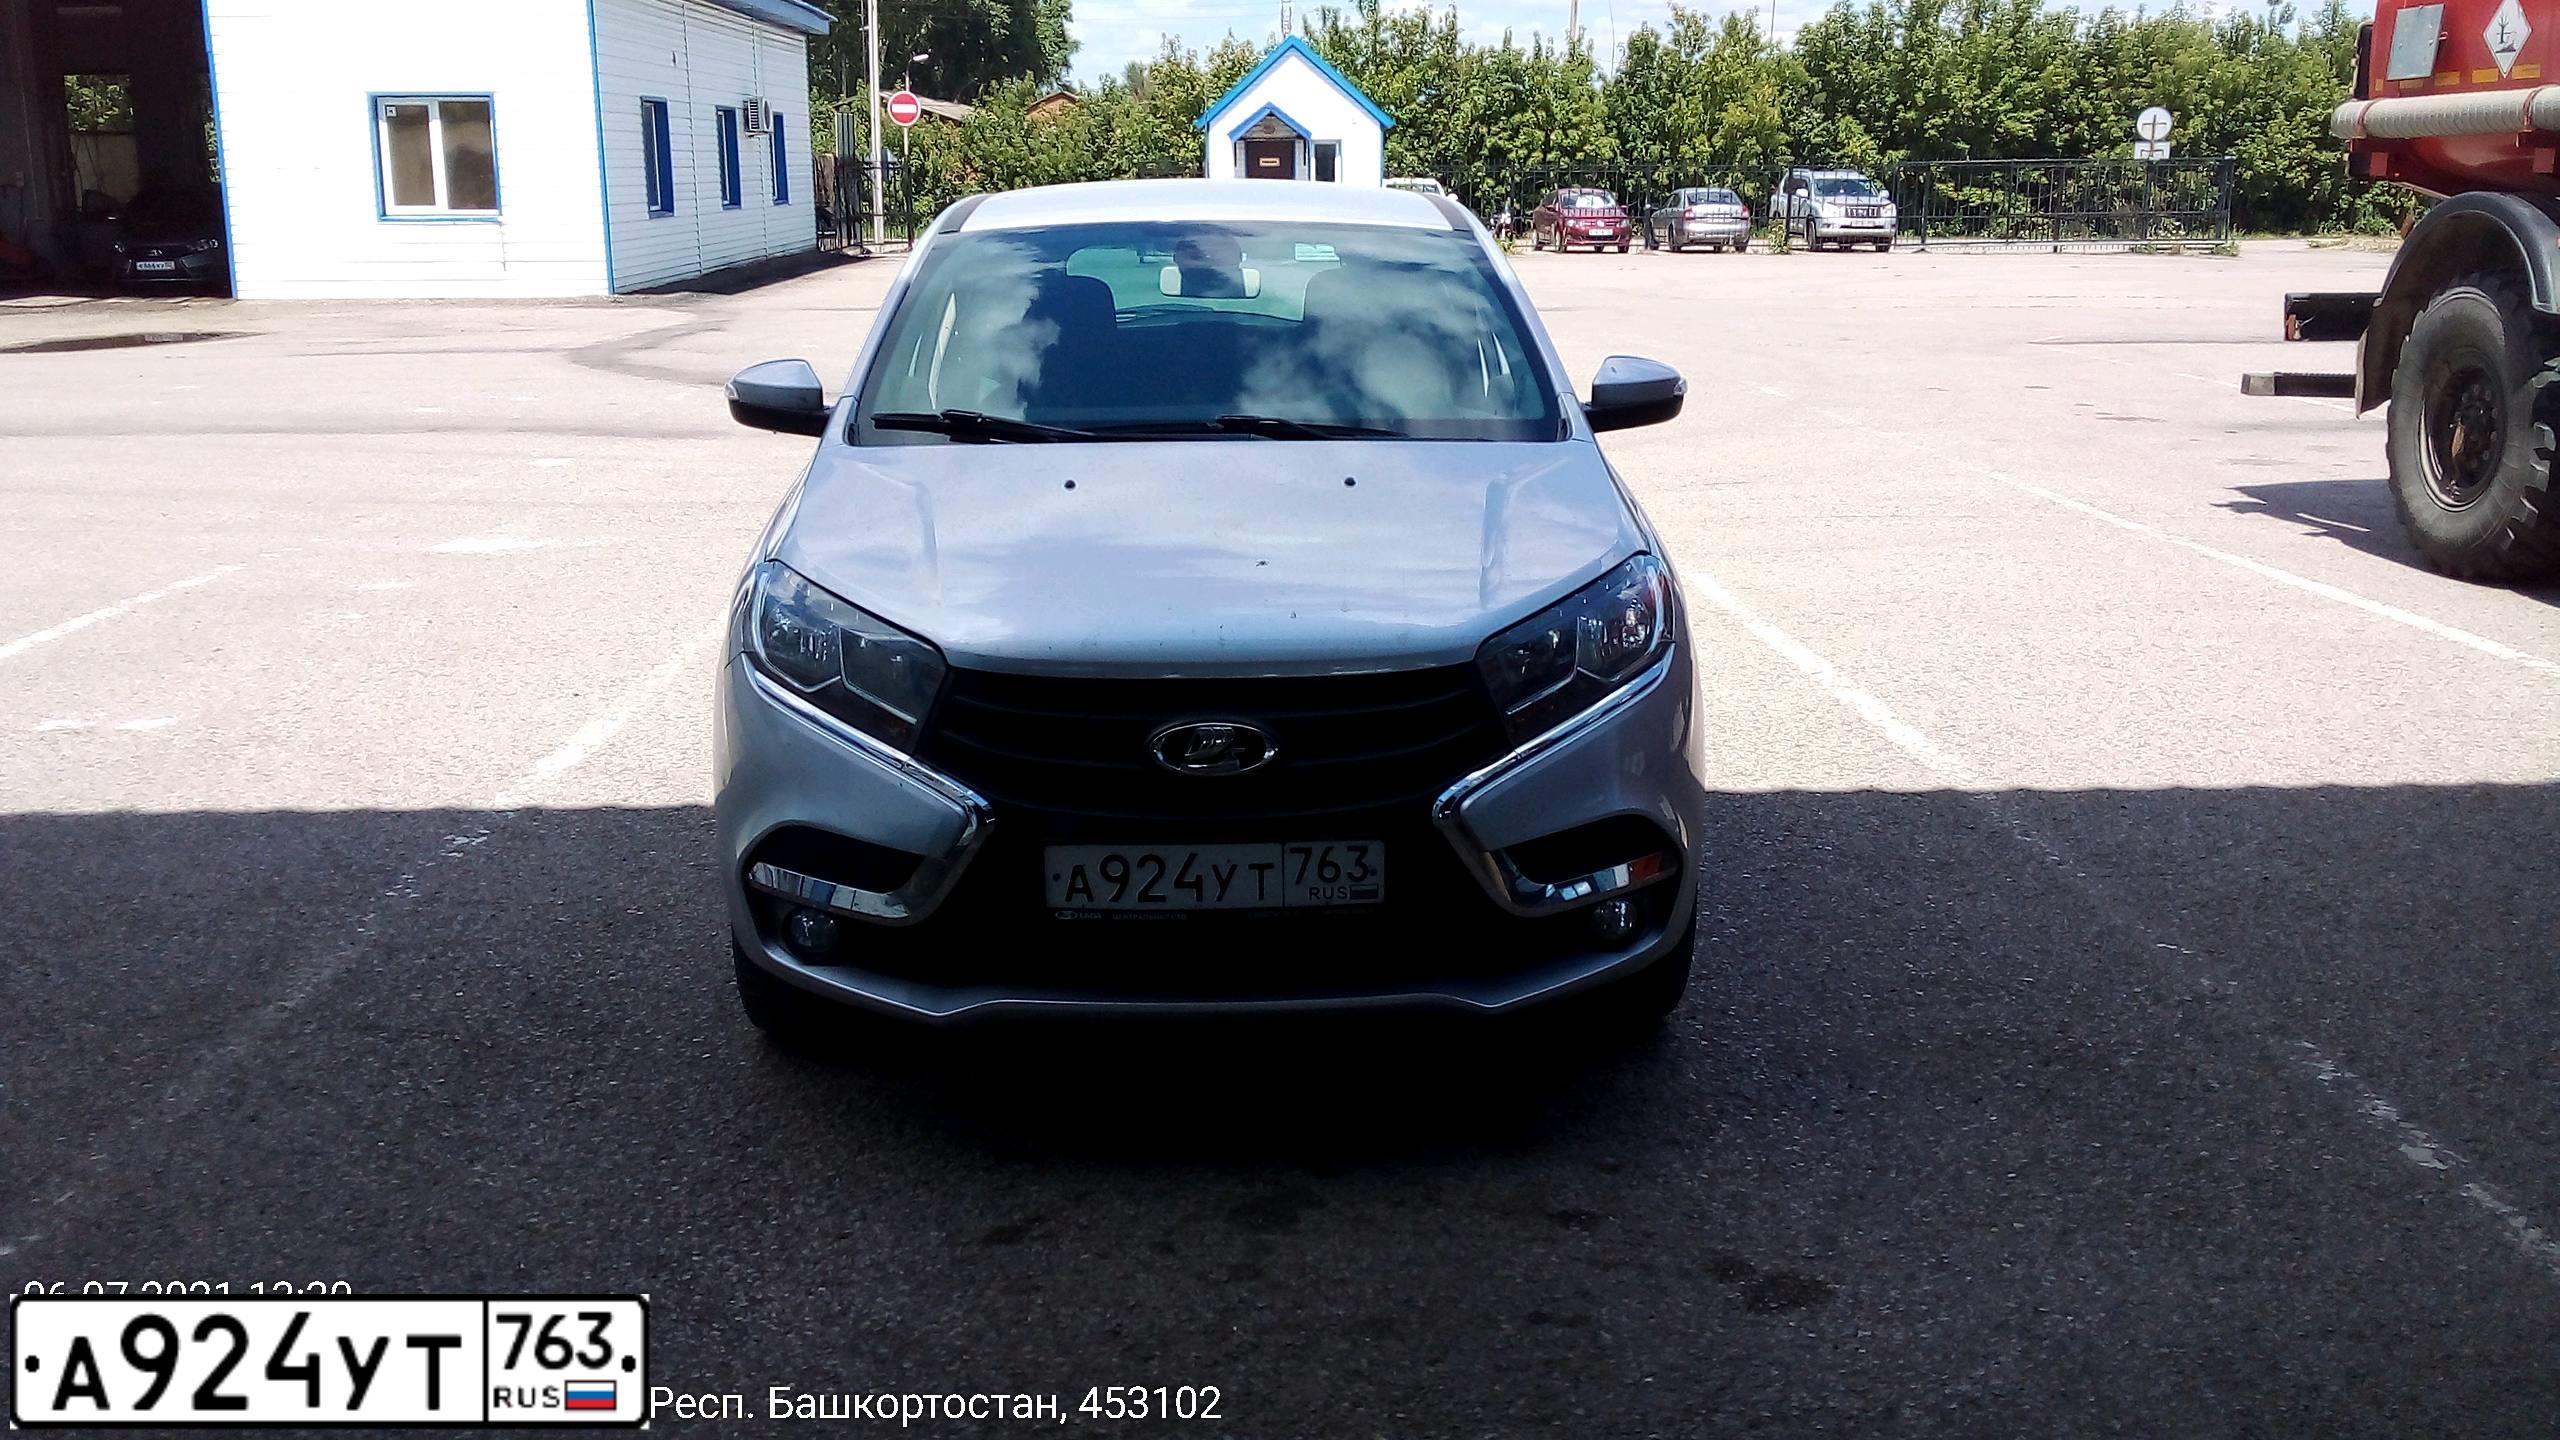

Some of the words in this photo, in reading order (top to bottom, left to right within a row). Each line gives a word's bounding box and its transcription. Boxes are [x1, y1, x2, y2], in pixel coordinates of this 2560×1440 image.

[1064, 851, 1275, 903] А924УТ
[1289, 845, 1369, 885] 763
[1308, 886, 1348, 900] RUS
